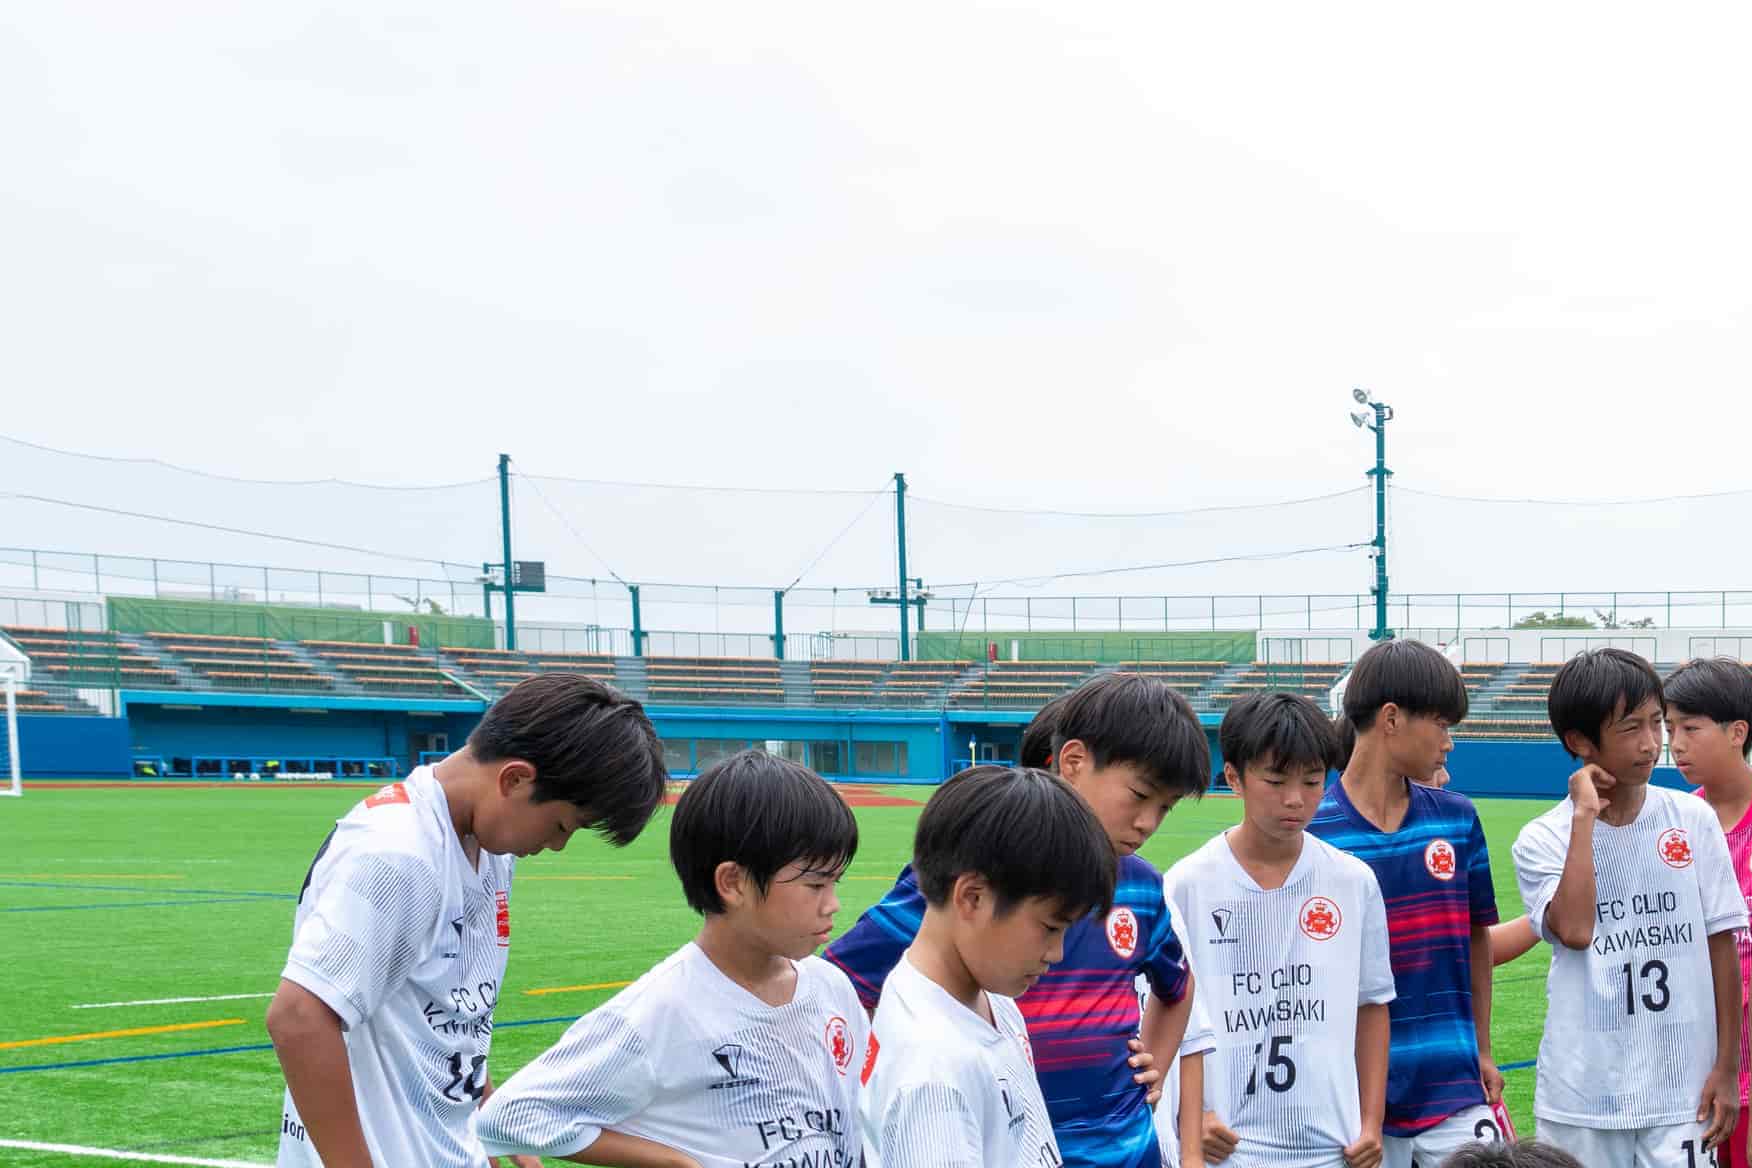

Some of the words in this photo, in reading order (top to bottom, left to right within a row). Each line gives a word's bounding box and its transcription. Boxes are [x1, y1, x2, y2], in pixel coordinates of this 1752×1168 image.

[1597, 899, 1625, 923] FC
[1632, 891, 1676, 915] CLIO
[1232, 971, 1262, 996] FC
[1623, 959, 1671, 1016] 13
[1245, 1035, 1297, 1093] 15
[757, 1115, 801, 1150] FC
